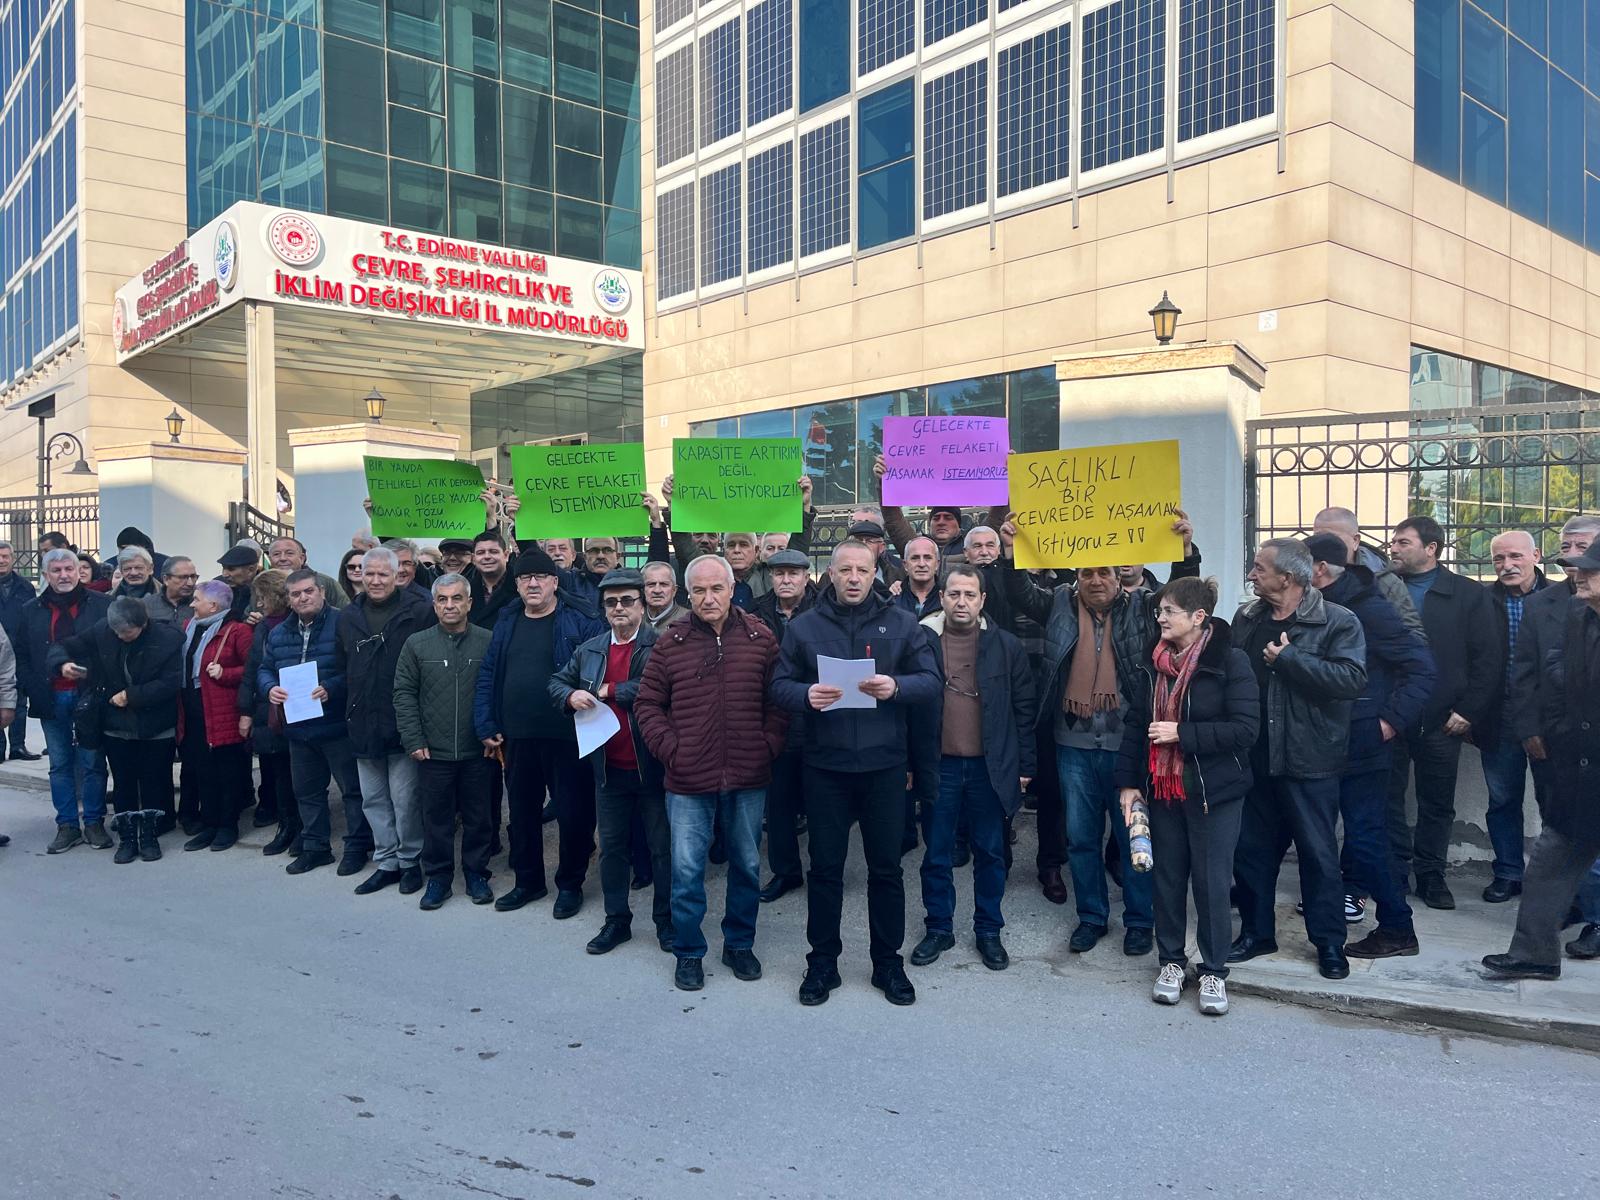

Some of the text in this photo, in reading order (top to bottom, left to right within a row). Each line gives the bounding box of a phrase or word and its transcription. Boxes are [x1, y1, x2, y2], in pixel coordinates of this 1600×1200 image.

[380, 231, 547, 273] T.C. EDİRNE VALİLİĞİ
[352, 253, 430, 285] ÇEVRE,
[435, 266, 545, 300] ŞEHİRCİLİK
[548, 283, 572, 305] VE
[275, 268, 628, 339] İKLİM DEĞİŞİKLİĞİ İL MÜDÜRLÜĞÜ
[912, 419, 991, 439] GELECEKTE
[546, 450, 617, 467] GELECEKTE
[678, 443, 743, 461] KAPASİTE
[391, 463, 424, 473] YANDA
[1028, 455, 1136, 489] SAĞLIKLI
[525, 469, 641, 493] ÇEVRE FELAKETİ
[678, 483, 718, 500] İPTAL
[549, 492, 641, 514] İSTEMİYORUZ
[1059, 485, 1096, 504] BİR
[1017, 501, 1177, 528] ÇEVREDE YAŞAMAK
